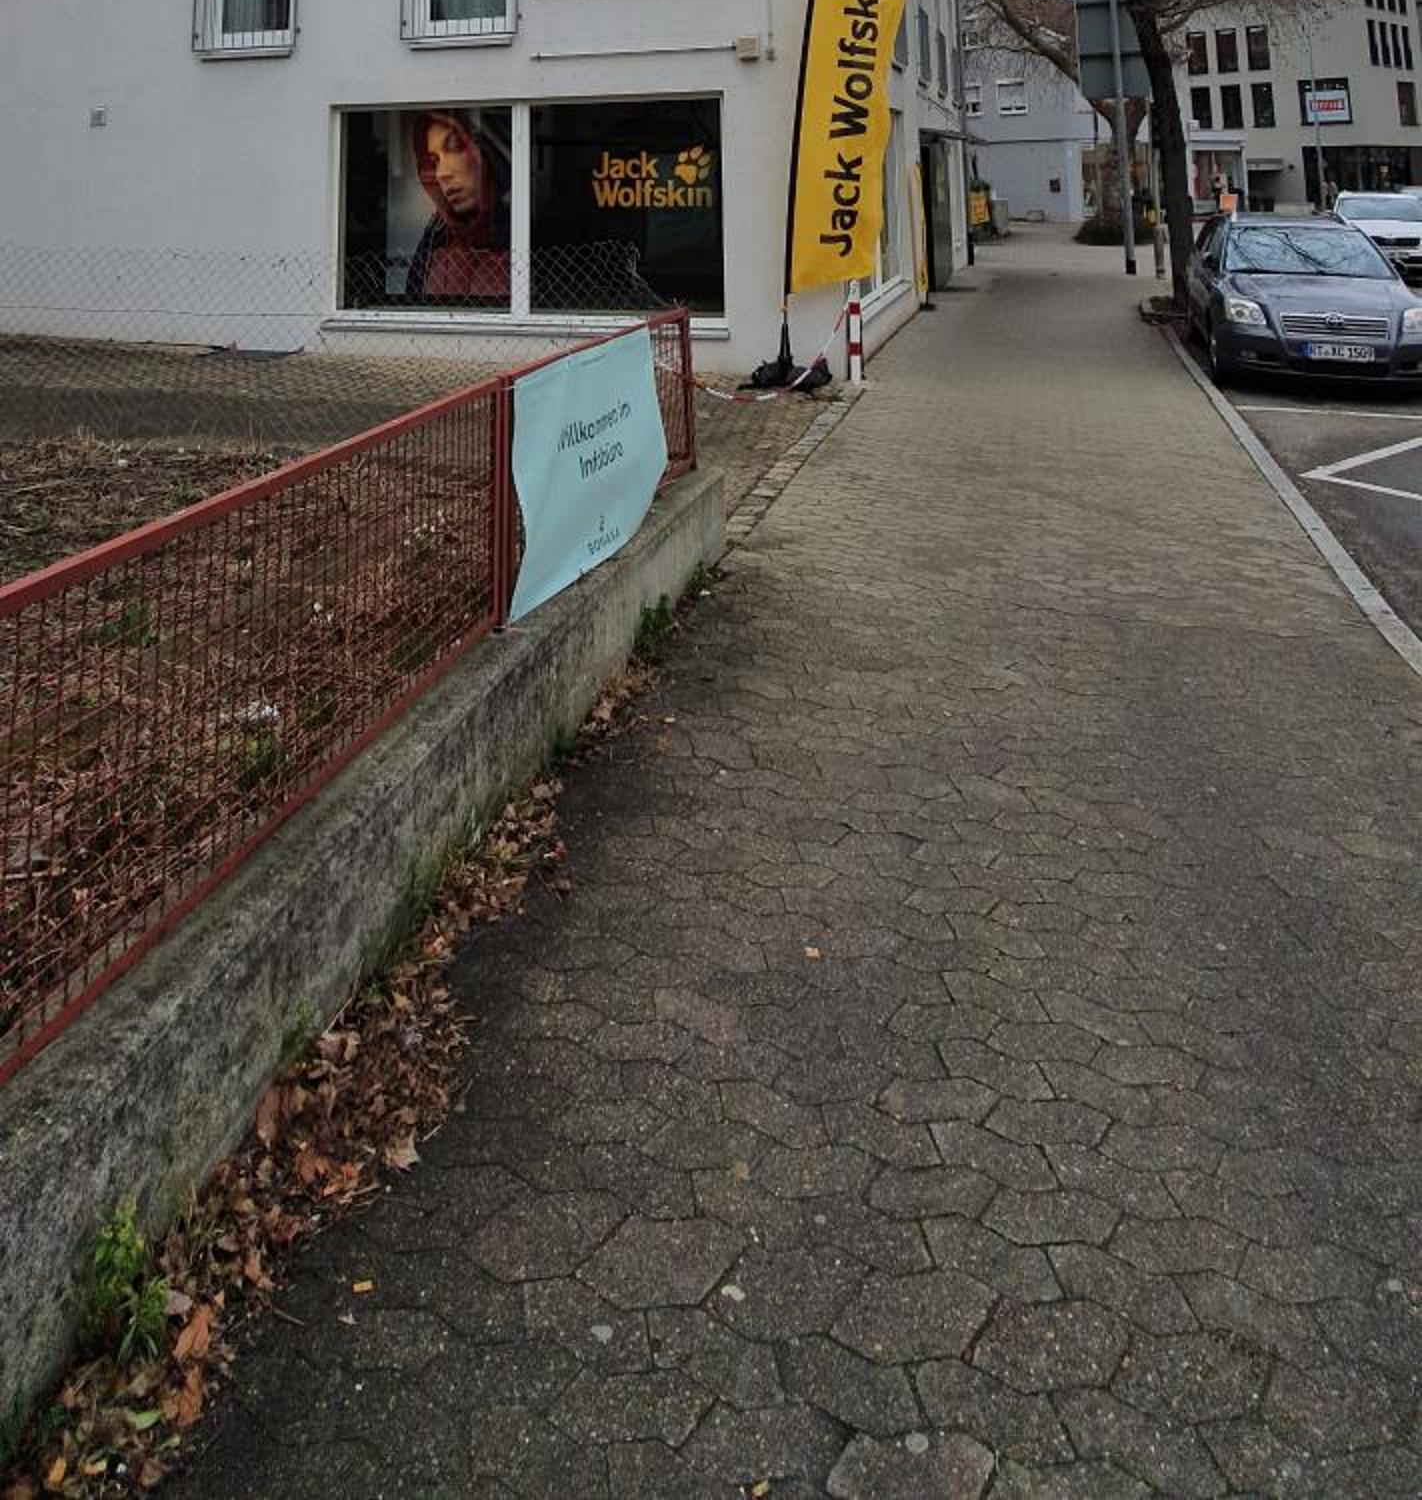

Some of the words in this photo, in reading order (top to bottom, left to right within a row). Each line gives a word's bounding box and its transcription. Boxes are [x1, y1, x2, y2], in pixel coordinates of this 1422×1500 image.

[592, 151, 659, 179] Jack
[592, 179, 713, 208] Wolfskin
[820, 152, 863, 257] Jack
